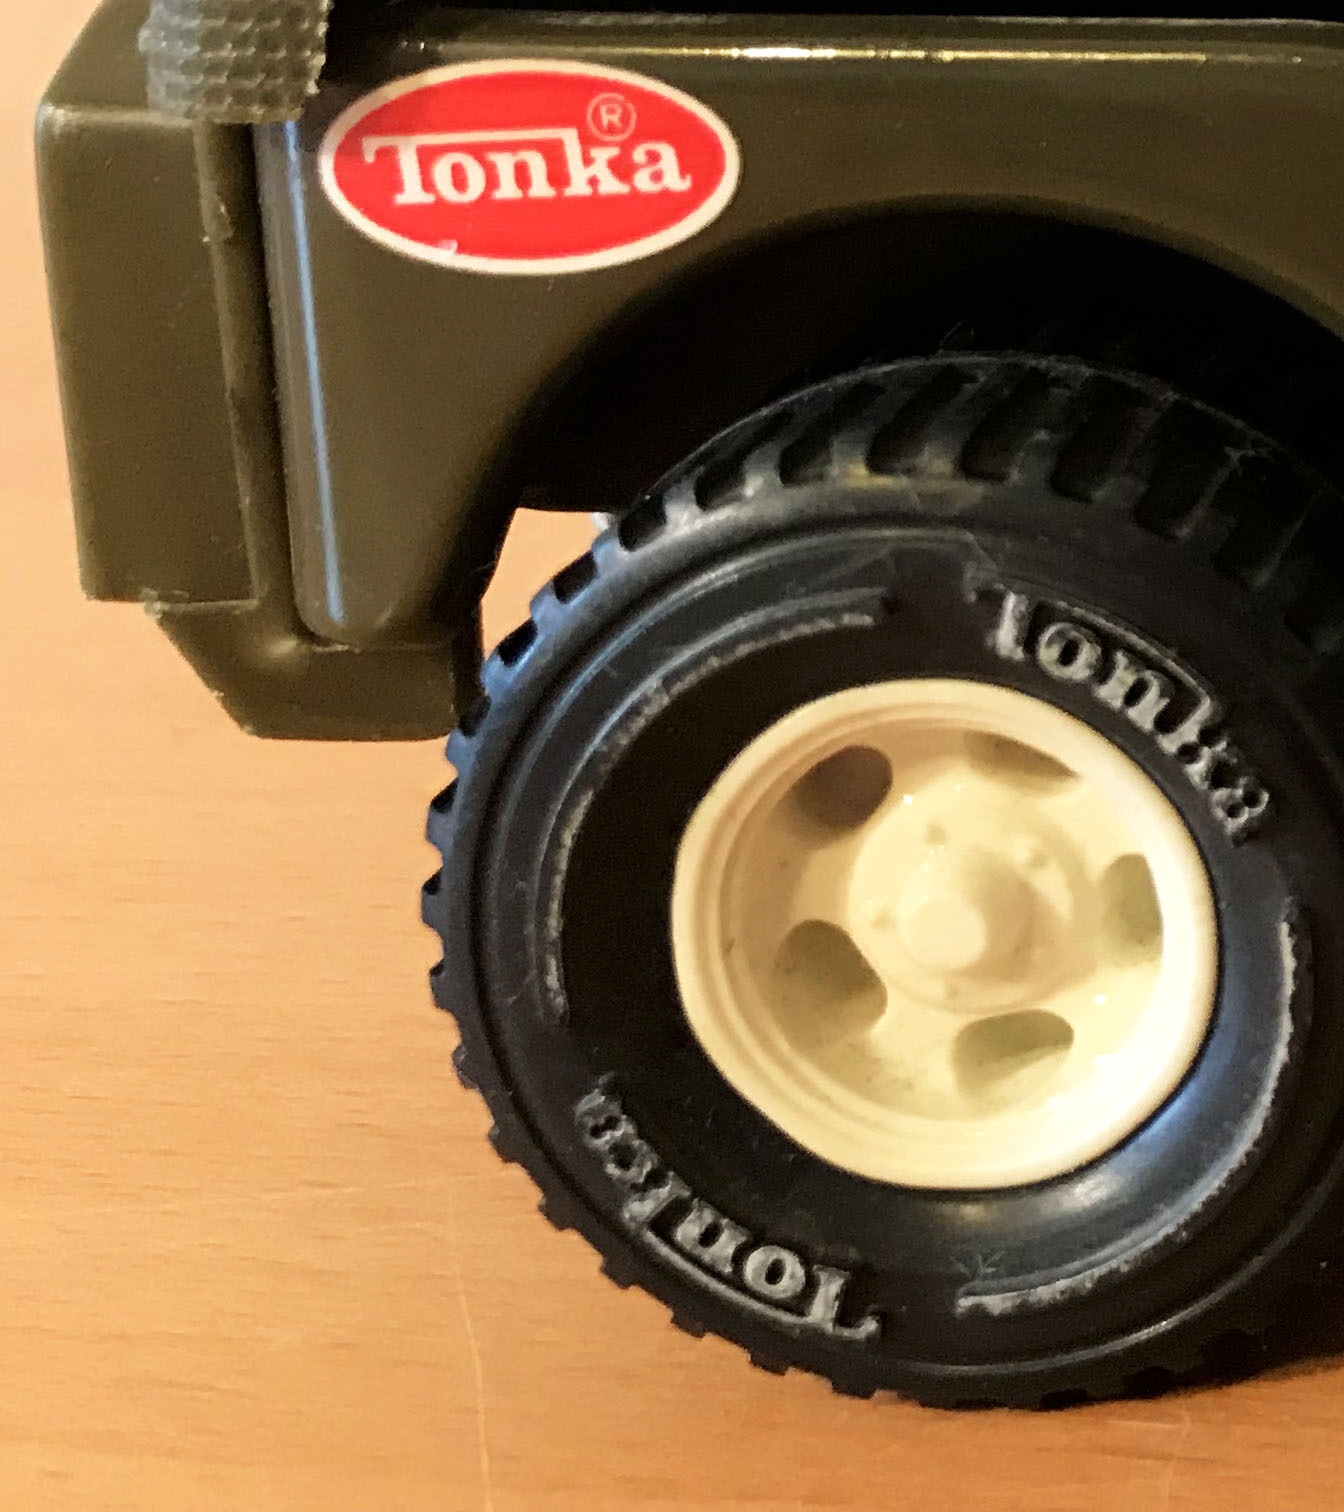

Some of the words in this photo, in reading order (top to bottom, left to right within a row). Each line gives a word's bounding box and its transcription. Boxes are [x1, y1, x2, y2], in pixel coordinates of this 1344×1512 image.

[362, 127, 692, 206] Tonka
[962, 568, 1270, 836] Tonka
[573, 1076, 882, 1340] Tonka
